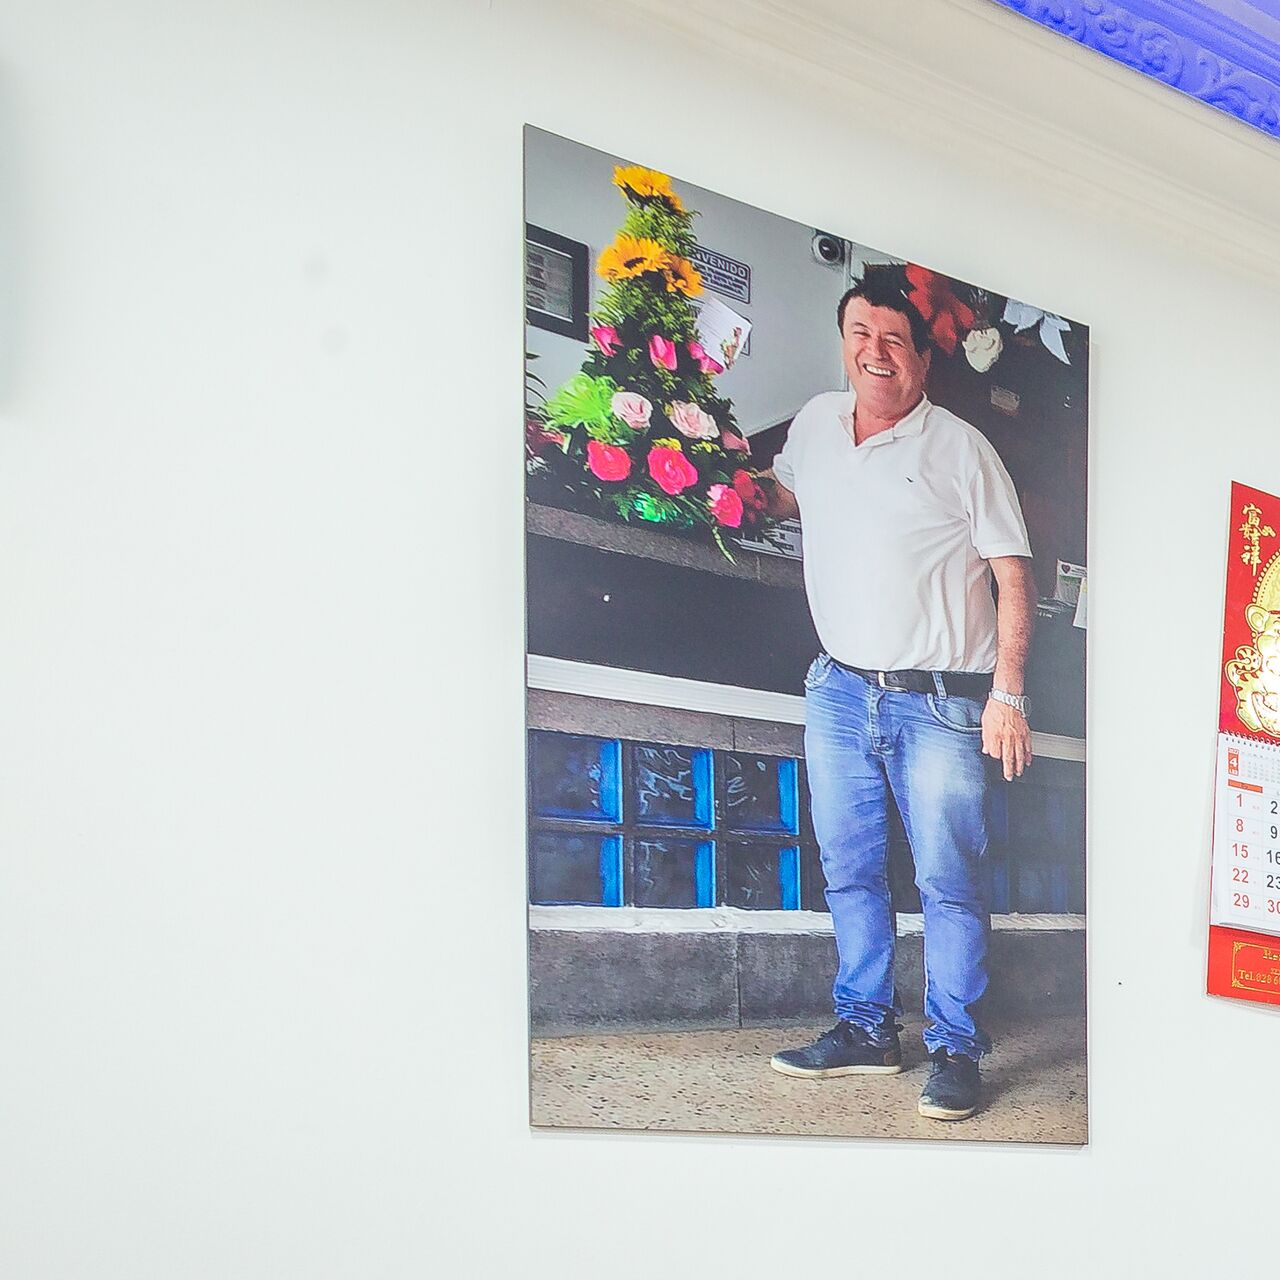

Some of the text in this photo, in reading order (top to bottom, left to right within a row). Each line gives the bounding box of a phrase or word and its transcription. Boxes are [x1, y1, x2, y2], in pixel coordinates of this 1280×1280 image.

[1236, 794, 1242, 808] 1
[1270, 801, 1278, 815] 2
[1236, 819, 1244, 833] 8
[1270, 826, 1278, 840] 9
[1232, 844, 1249, 859] 15
[1232, 868, 1249, 884] 22
[1233, 893, 1250, 909] 29
